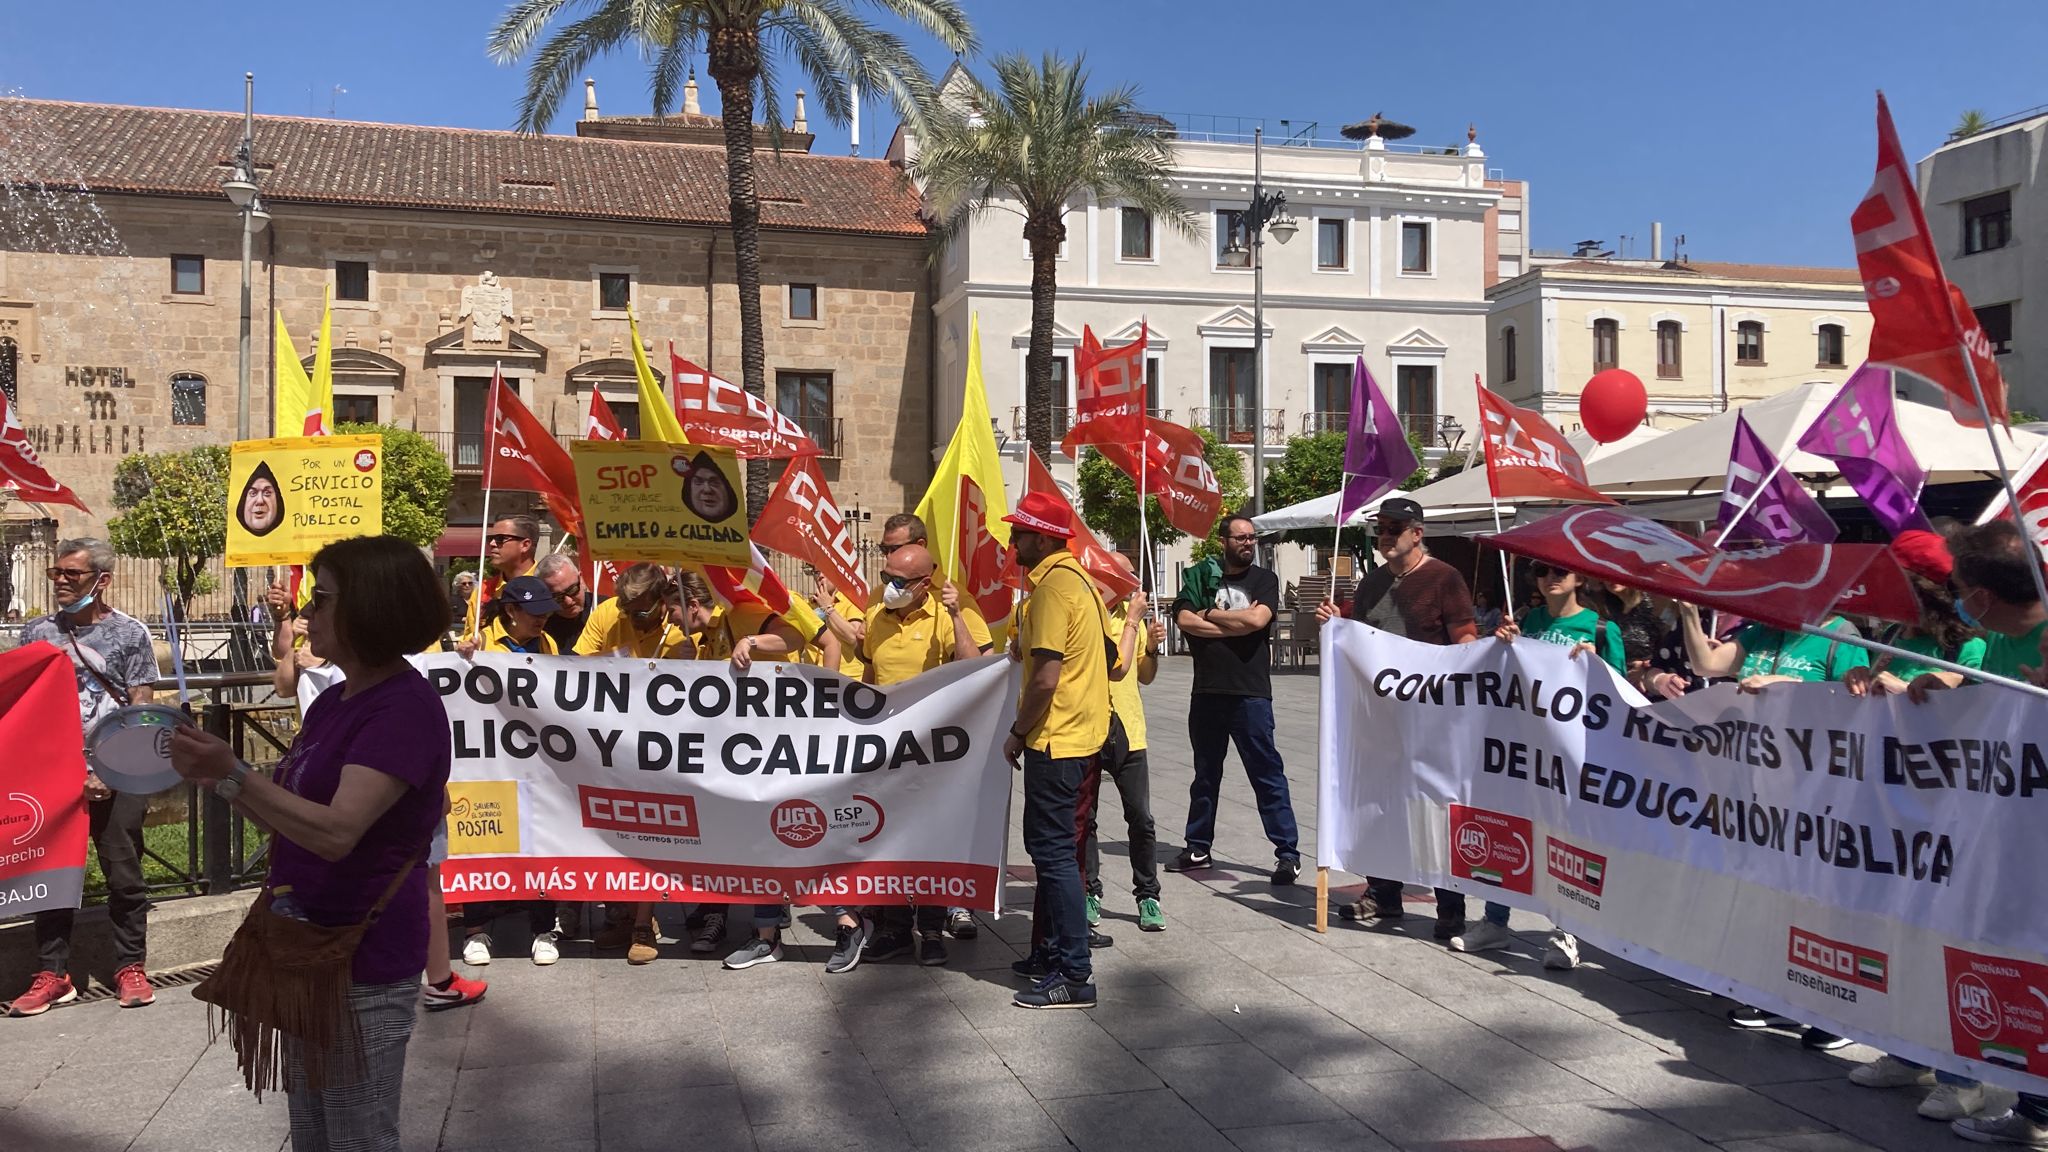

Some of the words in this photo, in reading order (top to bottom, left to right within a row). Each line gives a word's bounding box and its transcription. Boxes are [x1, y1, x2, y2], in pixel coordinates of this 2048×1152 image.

[65, 366, 136, 388] HOTEL
[55, 424, 145, 454] PALACE
[290, 475, 374, 492] SERVICIO
[309, 495, 363, 509] POSTAL
[596, 521, 660, 539] EMPLEO
[680, 524, 744, 542] CALIDAD
[428, 666, 538, 709] POR
[554, 670, 630, 714] UN
[646, 673, 887, 720] CORREO
[453, 719, 577, 762] LICO
[587, 728, 623, 768] Y
[638, 730, 704, 774] DE
[720, 726, 971, 776] CALIDAD
[1785, 728, 1813, 772] Y
[1828, 729, 1866, 782] EN
[1883, 736, 2048, 799] DEFENSA
[588, 796, 689, 827] CCOO
[776, 807, 818, 828] UGT
[1579, 762, 1789, 852] EDUCACIÓN
[1794, 805, 1954, 887] PÚBLICA
[457, 819, 503, 837] POSTAL
[637, 834, 672, 844] correos
[674, 837, 702, 847] postal
[1460, 828, 1487, 848] UGT
[1548, 844, 1585, 881] CCOO
[524, 866, 577, 890] MÁS
[583, 871, 599, 890] Y
[605, 871, 686, 892] MEJOR
[692, 874, 788, 898] EMPLEO,
[795, 872, 849, 896] MÁS
[856, 875, 977, 897] DERECHOS
[1557, 883, 1600, 912] enseñanza
[1793, 934, 1854, 976] CCOO
[1787, 968, 1857, 1003] enseñanza
[1958, 983, 1993, 1015] UGT
